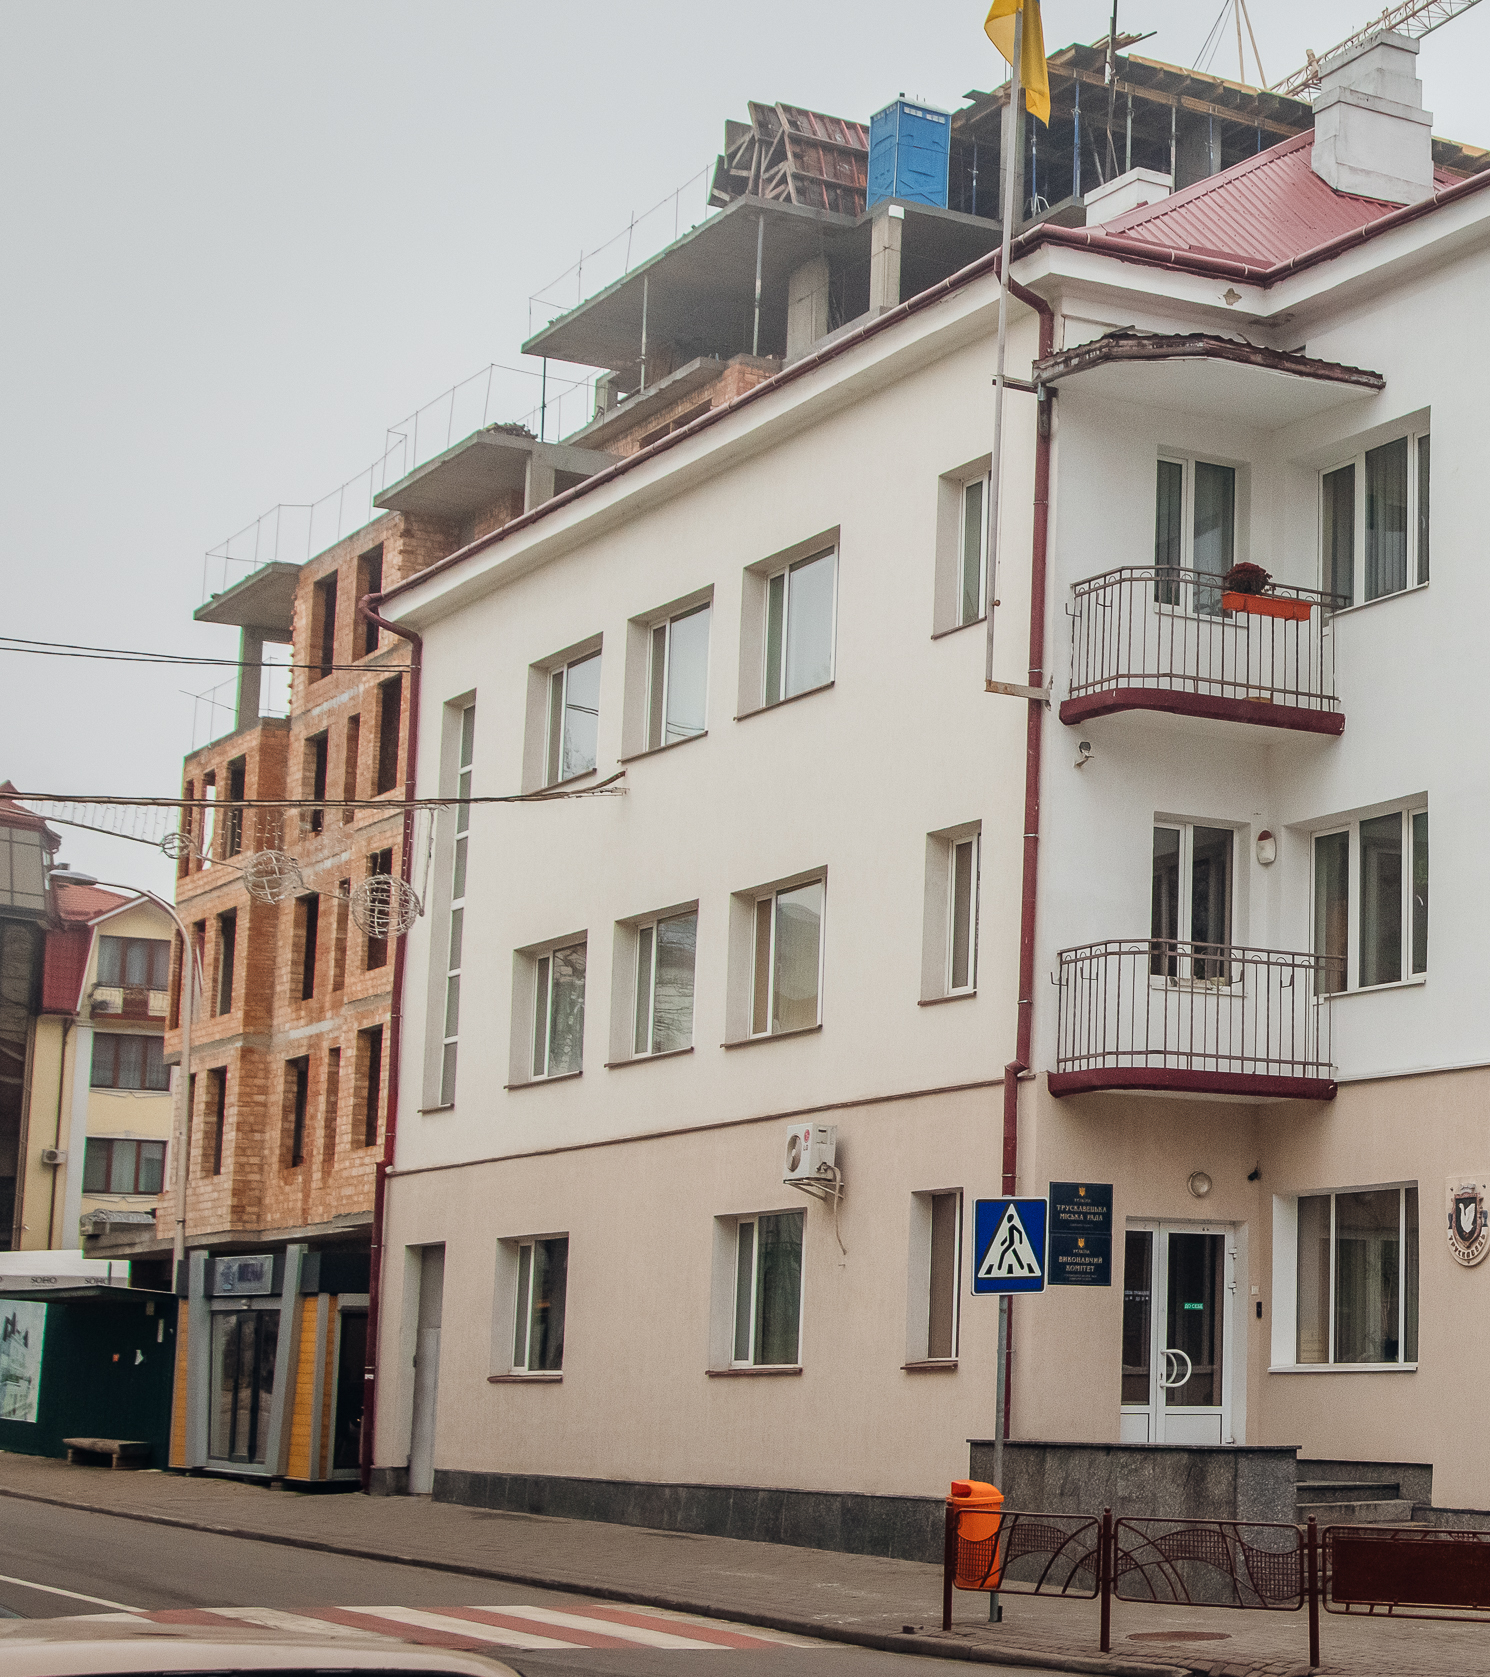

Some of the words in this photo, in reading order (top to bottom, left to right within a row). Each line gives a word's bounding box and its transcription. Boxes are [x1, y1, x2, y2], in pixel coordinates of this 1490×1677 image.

[1056, 1204, 1107, 1213] ТРУСКАВЕЦЬКА
[1058, 1255, 1103, 1264] ВИКОНАВЧИЙ
[1065, 1264, 1095, 1272] КОМІТЕТ
[31, 1276, 57, 1284] SOHO
